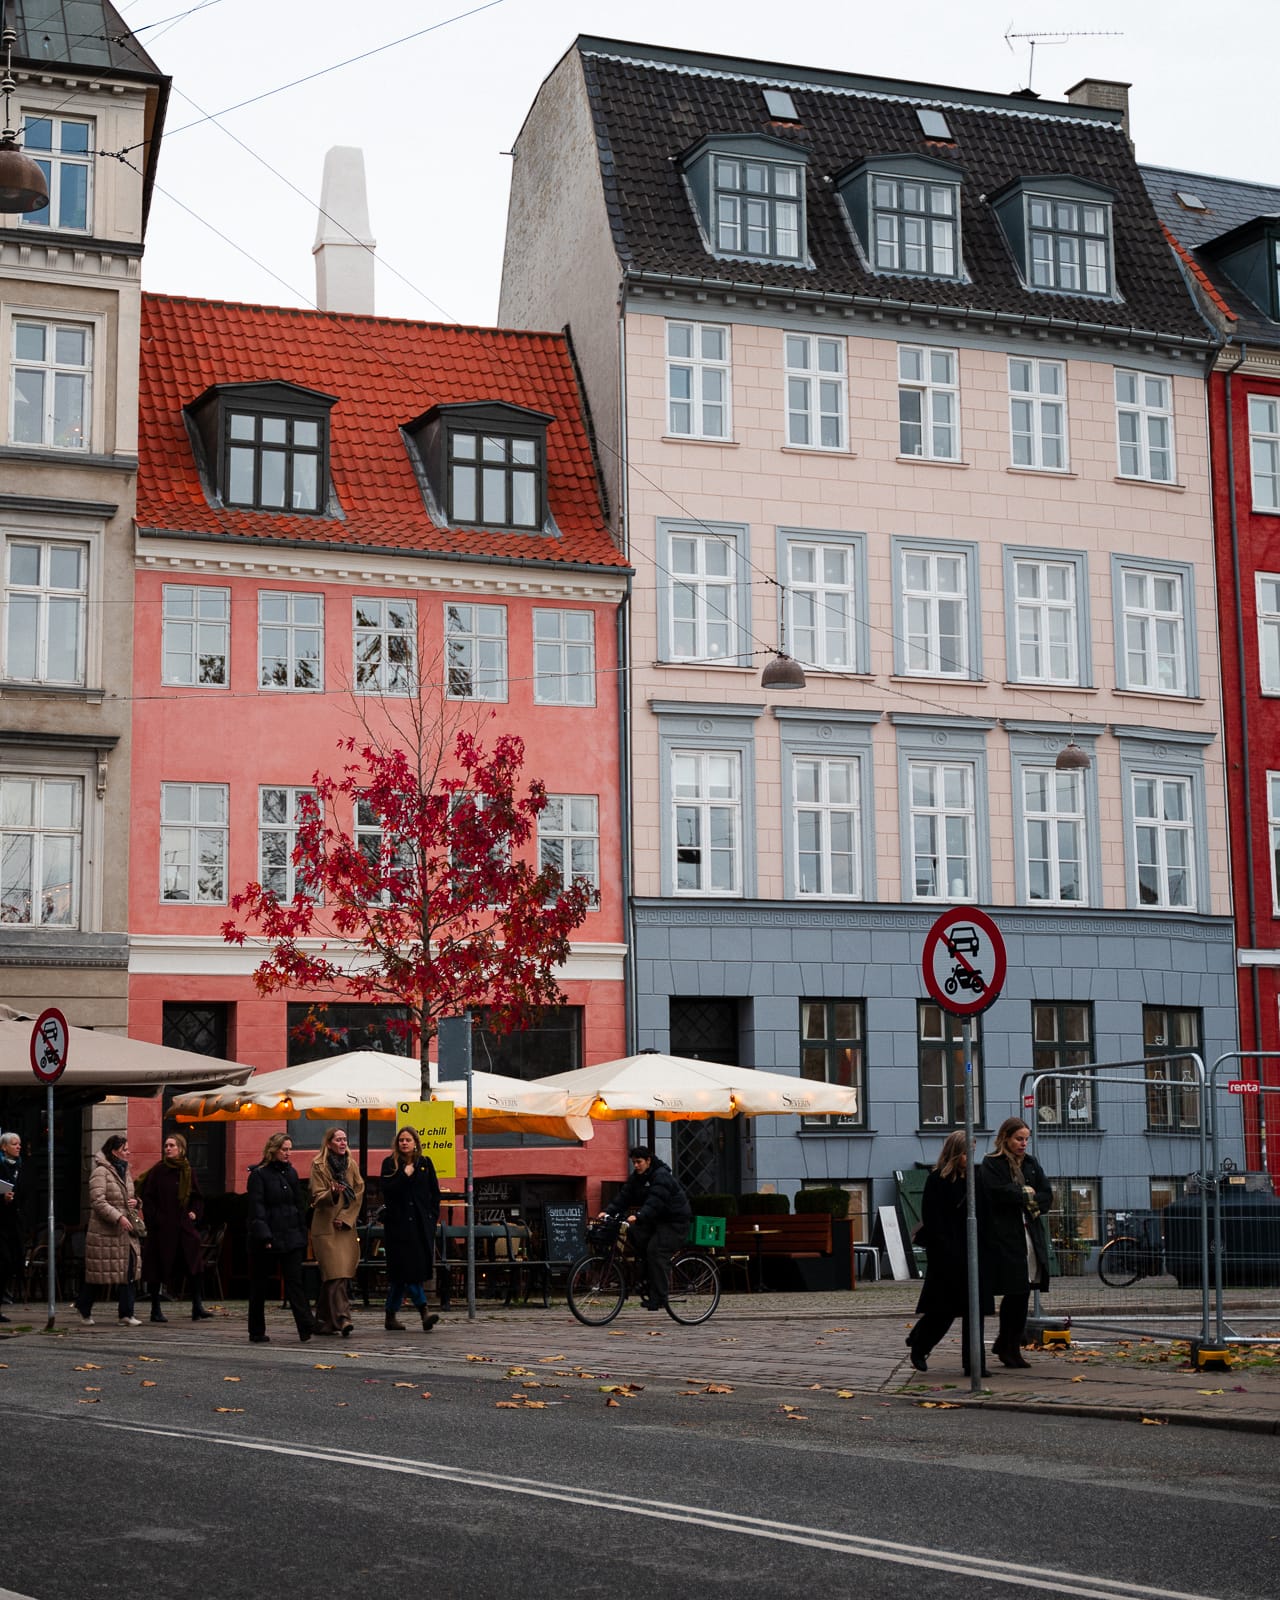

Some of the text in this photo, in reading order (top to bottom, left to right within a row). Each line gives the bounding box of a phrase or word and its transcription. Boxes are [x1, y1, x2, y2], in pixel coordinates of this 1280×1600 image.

[145, 1070, 182, 1081] CAFÉ
[1230, 1083, 1258, 1092] renta
[400, 1103, 409, 1113] Q
[427, 1127, 447, 1136] chili
[433, 1140, 452, 1149] hele
